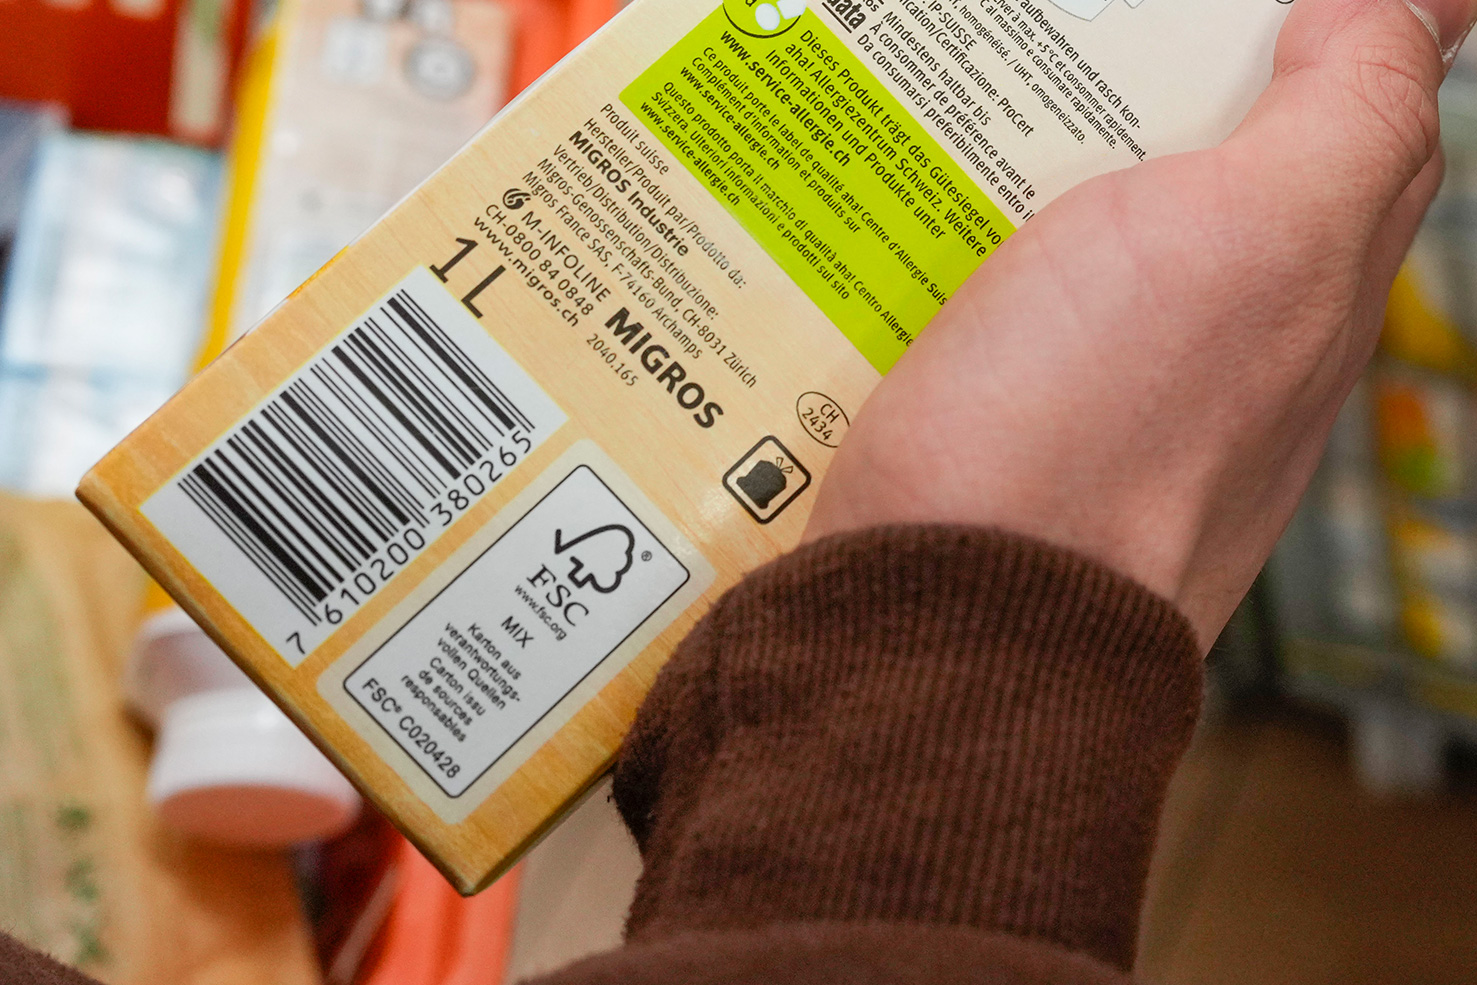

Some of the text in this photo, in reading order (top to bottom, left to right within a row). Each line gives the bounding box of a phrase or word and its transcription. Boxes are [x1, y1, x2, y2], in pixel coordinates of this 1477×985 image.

[719, 29, 851, 167] www.service-allergie.ch
[856, 32, 875, 53] Da
[871, 49, 931, 110] consumarsi
[922, 106, 1000, 186] preferibilmente
[996, 183, 1025, 213] entro
[868, 19, 1035, 200] À consommer de préférence avant le
[881, 10, 991, 126] Mindestens haltbar bis
[995, 96, 1034, 137] ProCert
[567, 129, 689, 257] MIGROS Industrie
[582, 116, 671, 208] Hersteller/Produit
[599, 102, 669, 175] Produit suisse
[764, 48, 946, 239] Informationen und Produkte unter
[783, 42, 987, 257] aha! Allergiezentrum Schweiz. Weitere
[798, 28, 1005, 249] Dieses Produkt trägt das Gütesiegel vo
[428, 236, 507, 319] 1 L
[472, 215, 579, 327] www.migros.ch
[484, 203, 594, 316] CH-0800 84 0848
[520, 209, 612, 303] M-INFOLINE
[520, 170, 703, 360] Migros France SAS, F-74160 Archamps
[535, 157, 757, 388] Migros-Genossenschafts-Bund, CH-8031 Zürich
[552, 143, 719, 320] Vertrieb/Distribution/Distribuzione:
[603, 305, 724, 429] MIGROS
[819, 402, 840, 424] CH
[795, 406, 833, 446] 2434
[284, 429, 532, 655] 7 610200 380265
[525, 563, 590, 627] FSC
[500, 614, 534, 648] MIX
[397, 714, 461, 779] C020428
